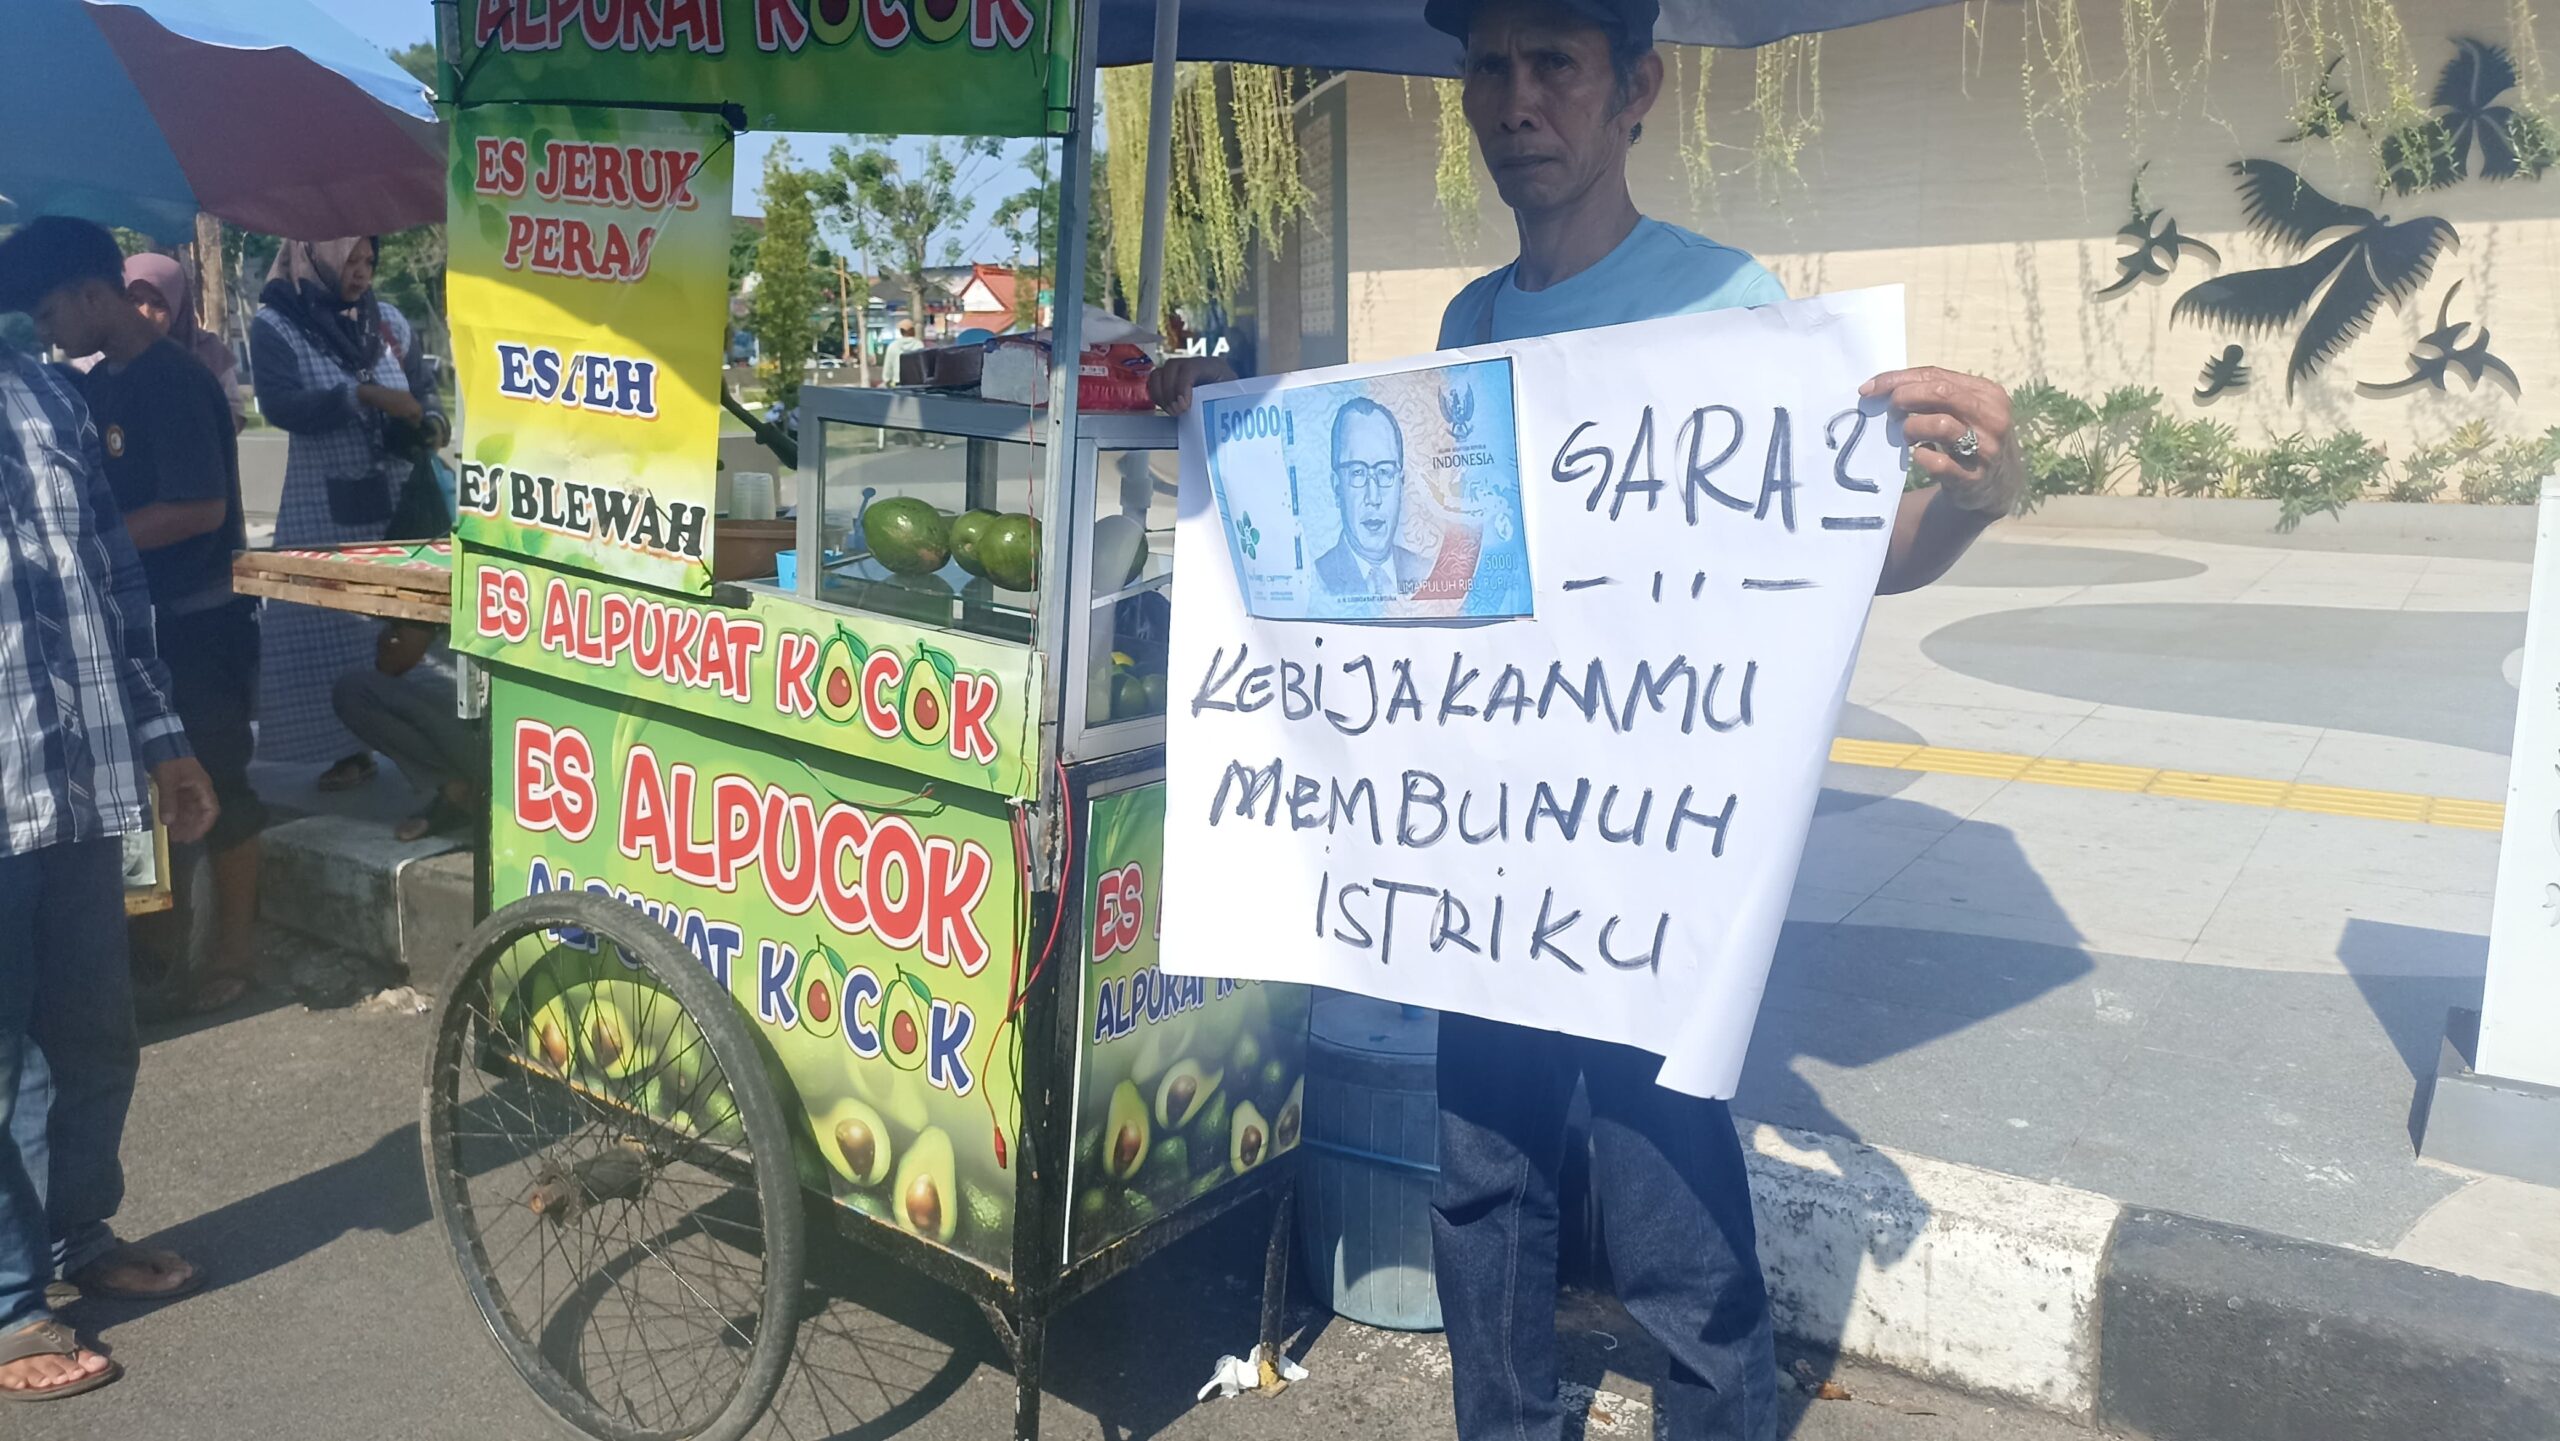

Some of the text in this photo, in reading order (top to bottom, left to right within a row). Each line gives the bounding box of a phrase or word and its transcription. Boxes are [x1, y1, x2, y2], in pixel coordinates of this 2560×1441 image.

[475, 136, 700, 210] ES JERUK
[496, 342, 561, 401] ES
[1220, 404, 1280, 443] 50000
[1432, 452, 1495, 470] INDONESIA
[509, 470, 706, 558] BLEWAH
[1422, 577, 1456, 593] PULUH
[476, 565, 529, 644] ES
[541, 577, 765, 703] ALPUKAT
[514, 718, 992, 976] ES ALPUCOK
[1092, 861, 1144, 963] ES
